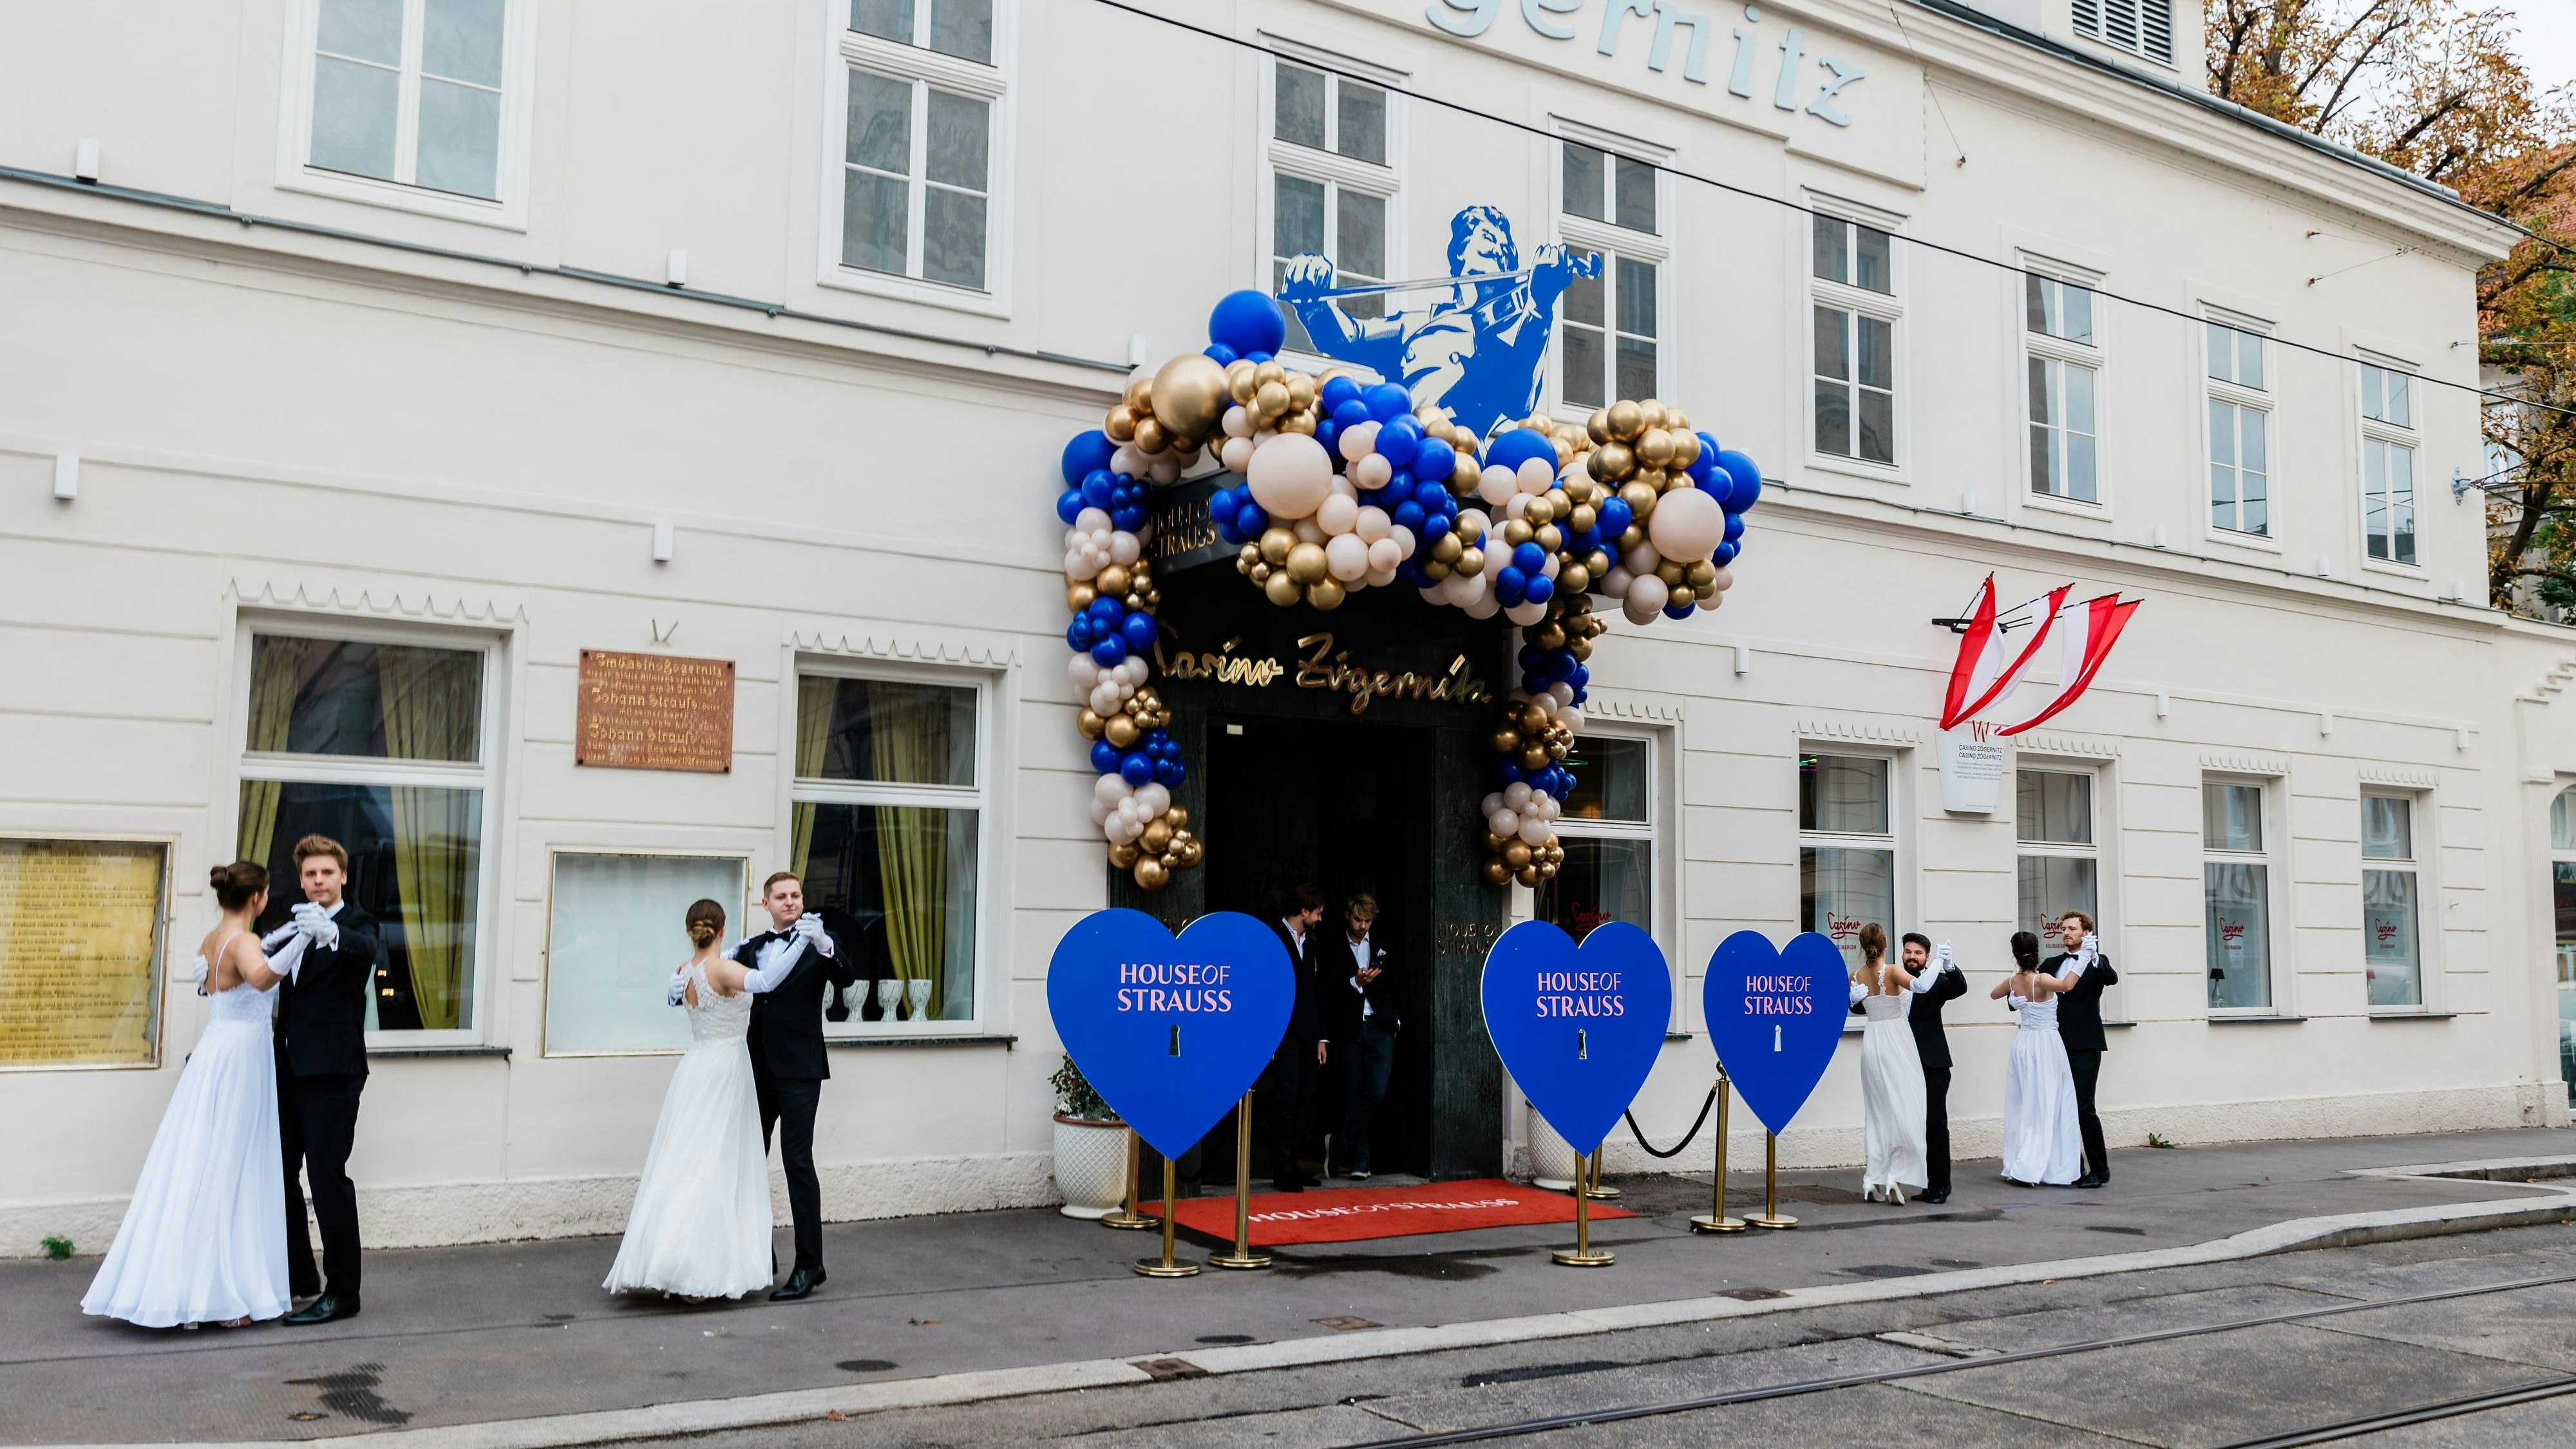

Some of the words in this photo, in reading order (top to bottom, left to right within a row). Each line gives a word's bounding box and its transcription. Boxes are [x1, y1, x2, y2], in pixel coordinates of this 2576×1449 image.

[592, 687, 645, 706] Johann
[589, 723, 643, 742] Johann
[1827, 911, 1861, 939] Casino
[2219, 917, 2245, 941] Casino
[2374, 918, 2397, 940] Casino
[1117, 988, 1232, 1012] STRAUSS
[1537, 995, 1624, 1018] STRAUSS
[1744, 996, 1812, 1015] STRAUSS
